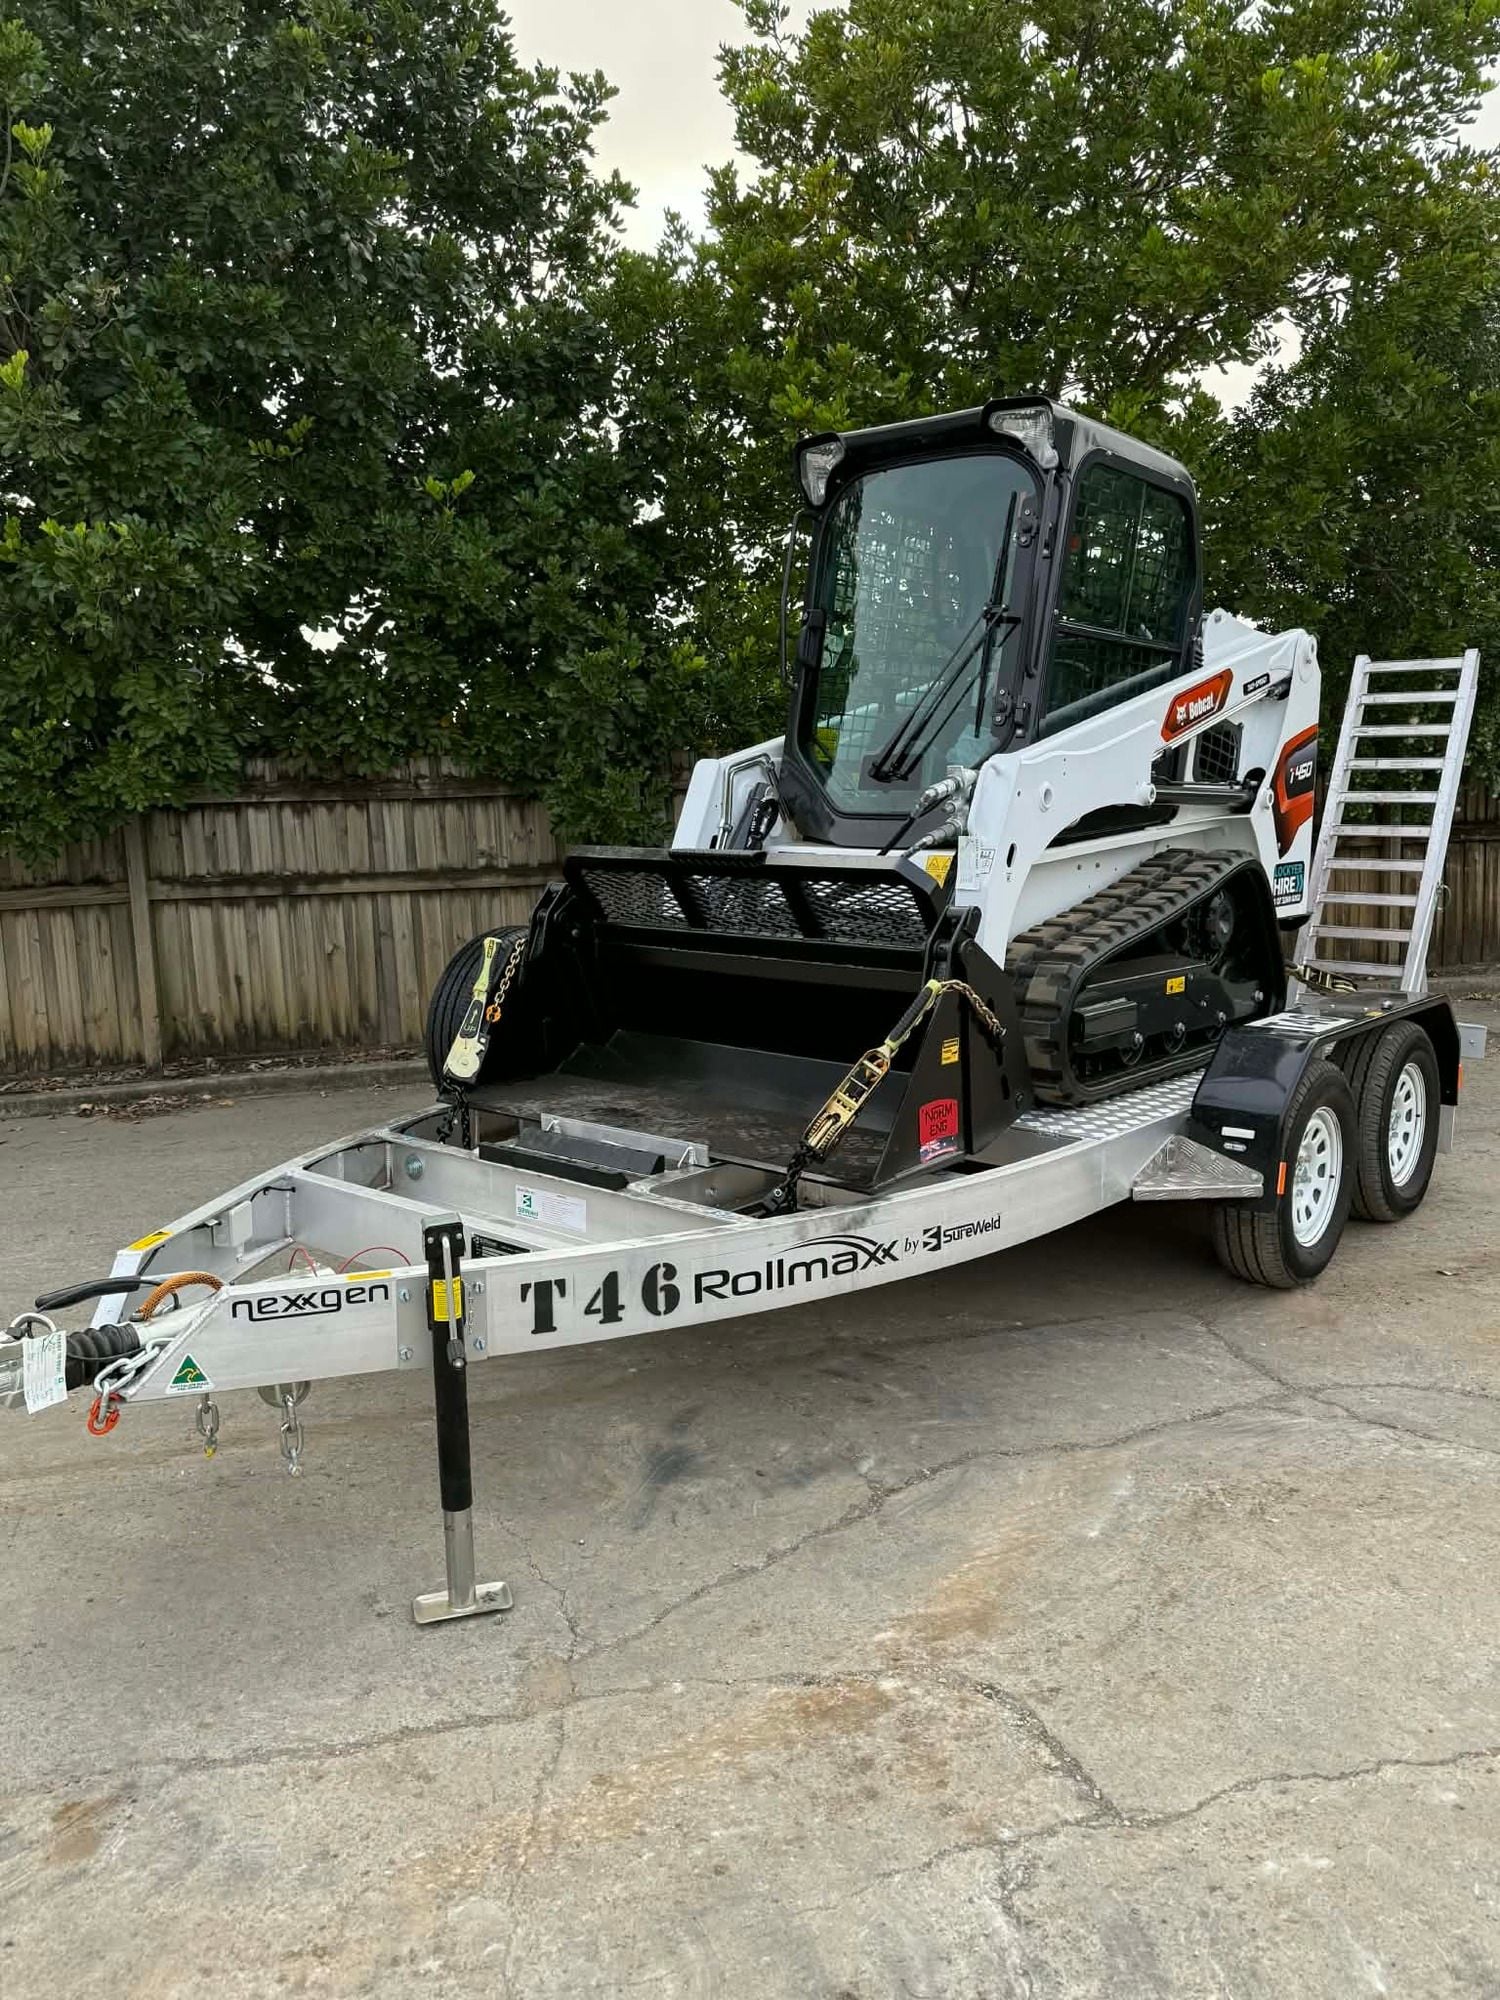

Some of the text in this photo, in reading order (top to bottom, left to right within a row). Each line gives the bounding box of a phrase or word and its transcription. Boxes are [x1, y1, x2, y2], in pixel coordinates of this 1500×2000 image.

[1188, 691, 1215, 720] Bobcat
[1273, 876, 1297, 896] HIRE
[694, 1215, 1001, 1304] Rollmaxx by SureWeld
[232, 1284, 389, 1322] nexxgen
